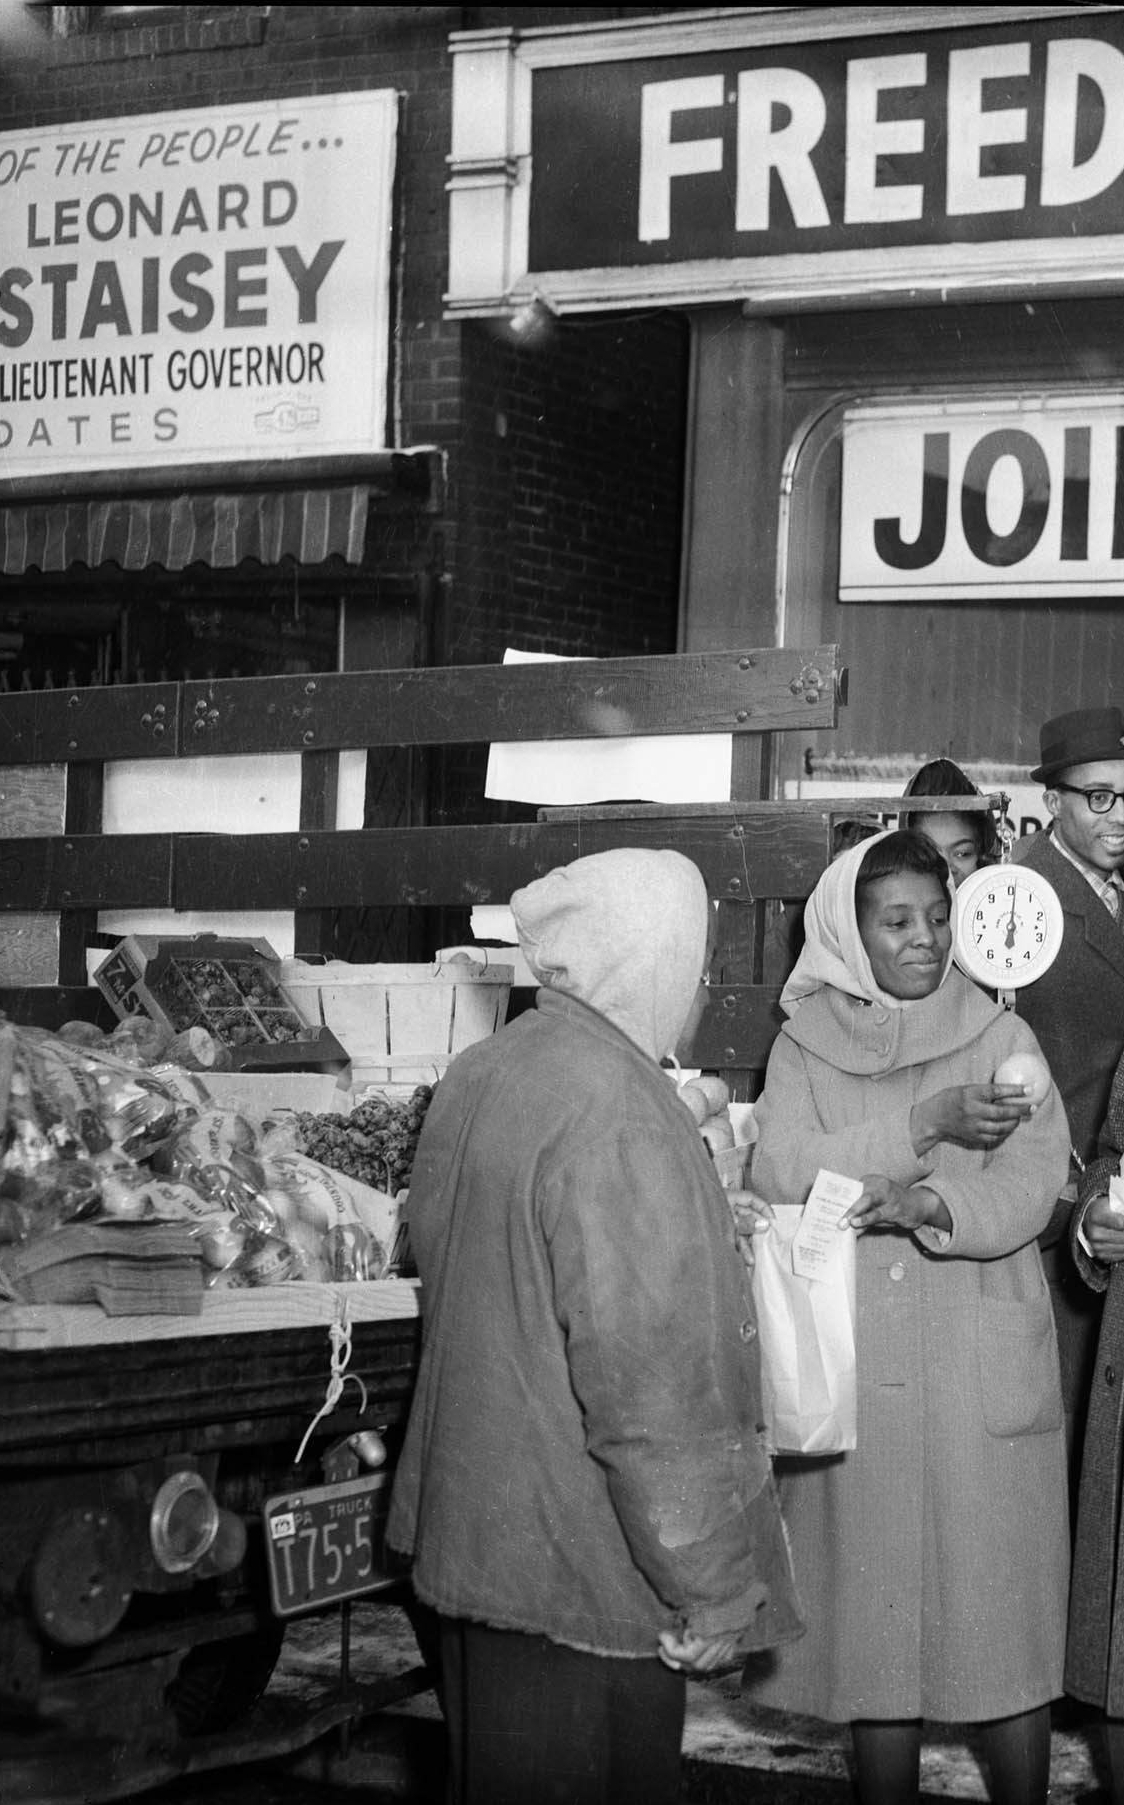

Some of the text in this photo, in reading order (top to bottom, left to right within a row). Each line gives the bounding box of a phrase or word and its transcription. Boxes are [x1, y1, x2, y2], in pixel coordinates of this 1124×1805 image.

[0, 147, 40, 186] OF
[55, 139, 126, 177] THE
[27, 180, 298, 248] LEONARD
[0, 240, 346, 348] STAISEY
[0, 342, 325, 402] LIEUTENANT GOVERNOR
[1007, 885, 1015, 896] 0
[988, 893, 996, 904] 9
[976, 911, 984, 921] 8
[1036, 911, 1044, 921] 2
[976, 934, 984, 944] 7
[1035, 932, 1043, 943] 3
[986, 949, 994, 960] 6
[1023, 950, 1031, 960] 4
[1005, 957, 1013, 968] 5
[328, 1496, 373, 1519] TRUCK
